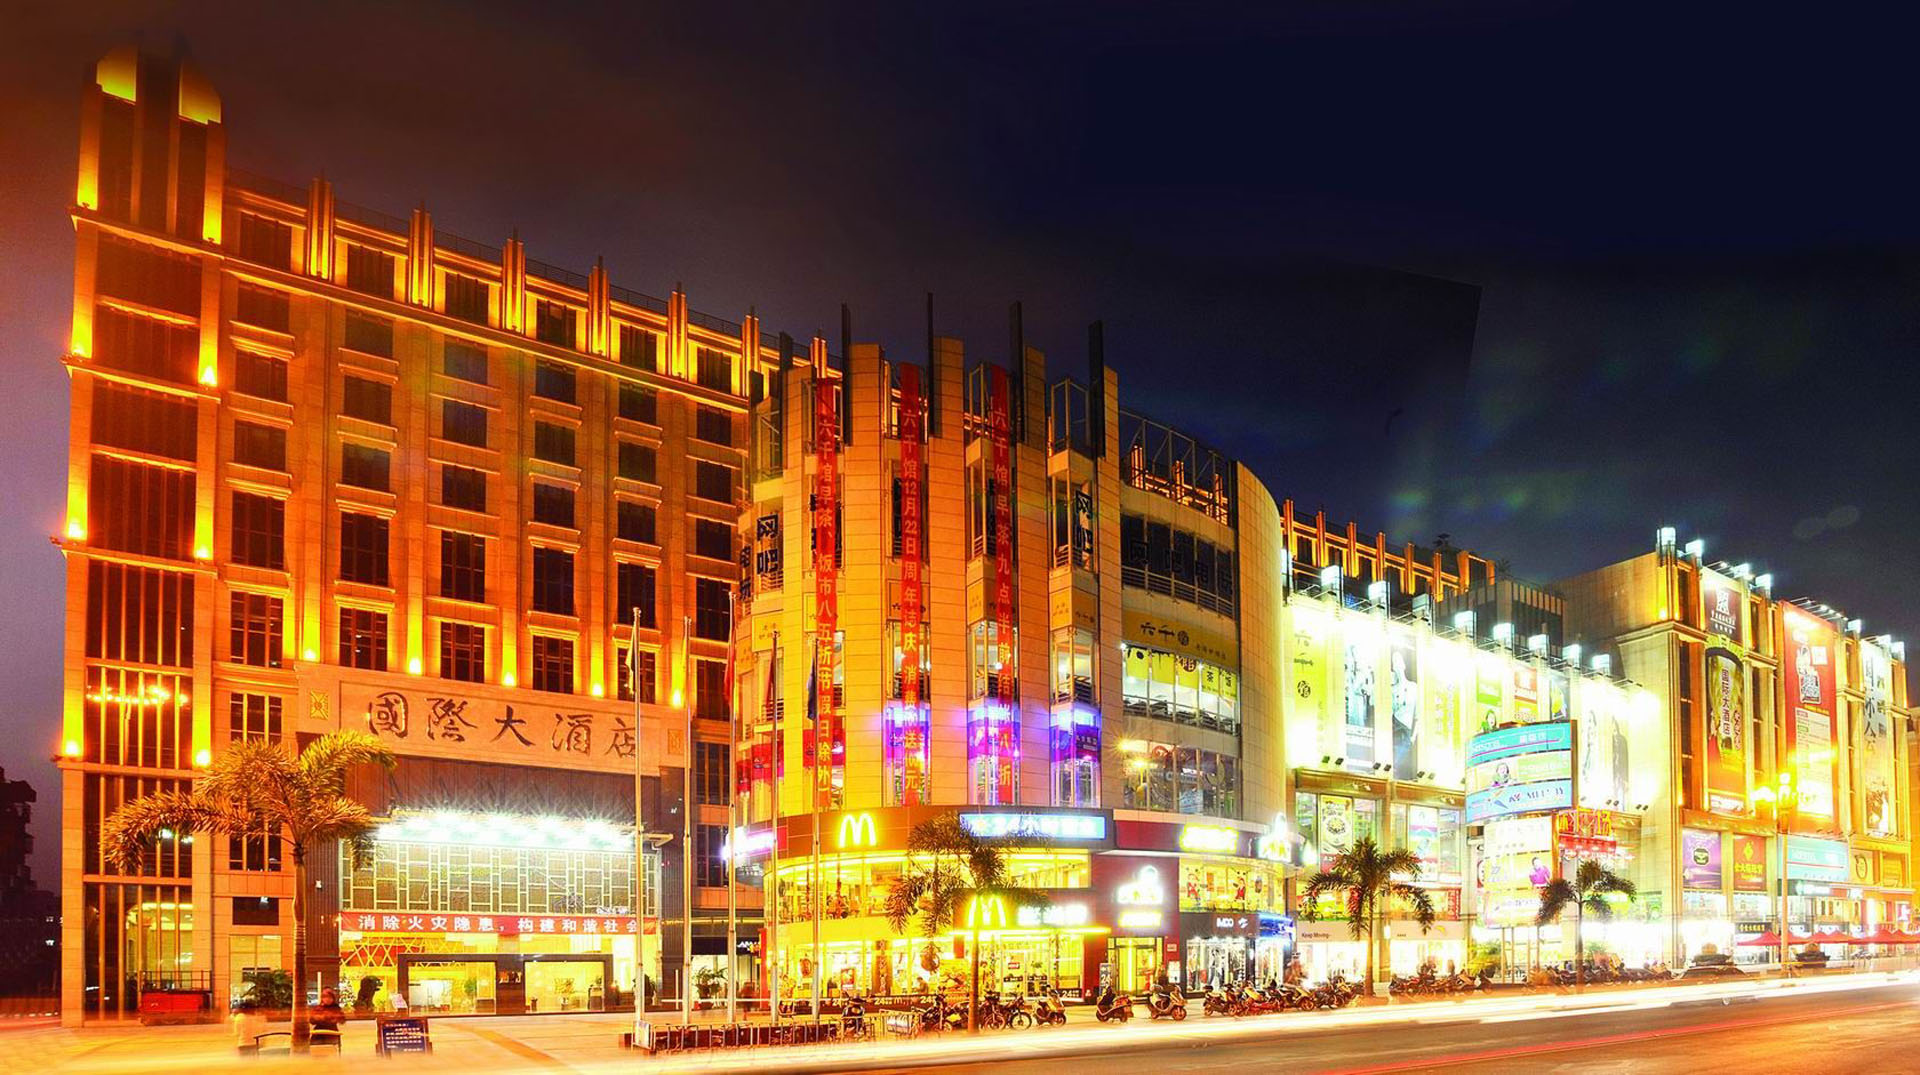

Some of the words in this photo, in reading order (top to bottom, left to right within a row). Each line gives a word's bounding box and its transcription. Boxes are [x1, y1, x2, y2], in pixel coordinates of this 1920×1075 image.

[368, 692, 637, 758] 國際大酒店
